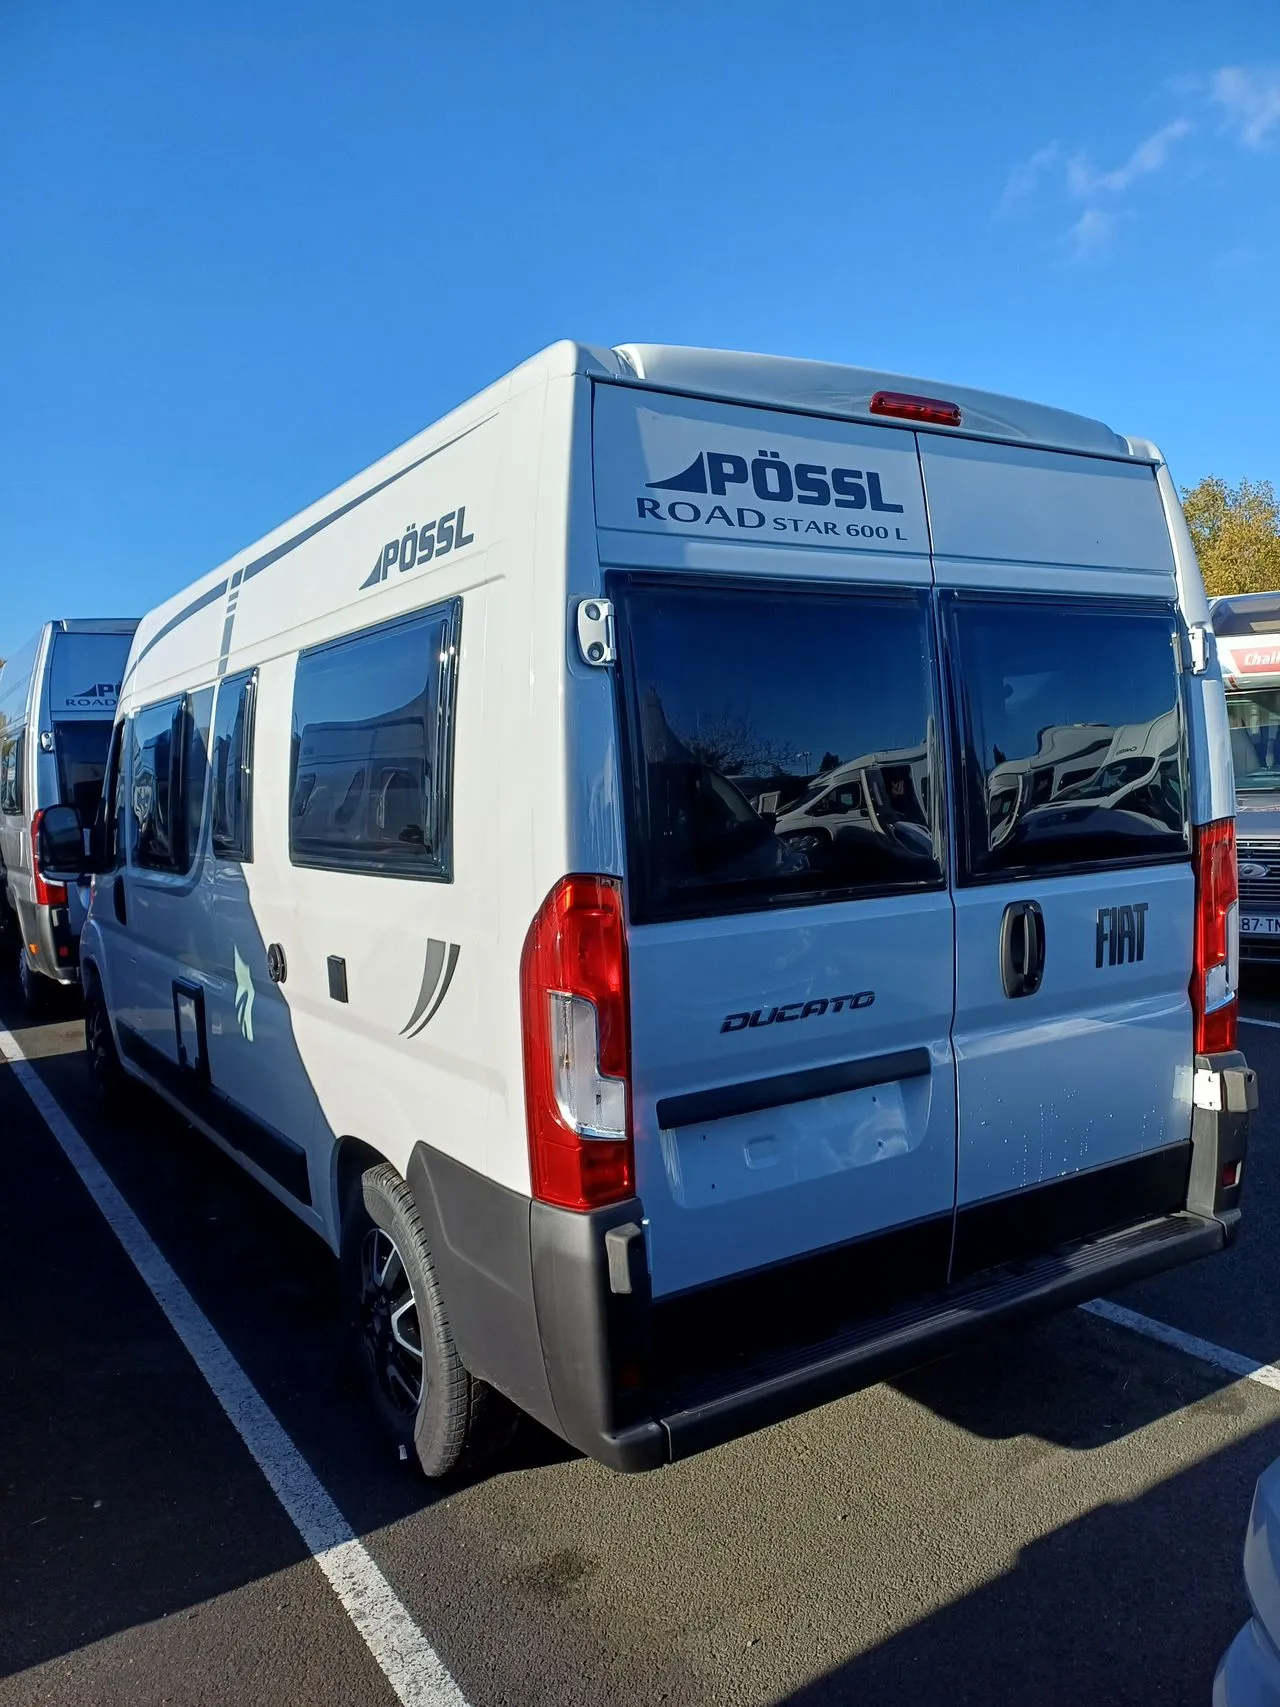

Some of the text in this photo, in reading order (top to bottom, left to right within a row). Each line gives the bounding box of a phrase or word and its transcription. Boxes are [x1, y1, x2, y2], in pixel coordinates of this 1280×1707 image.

[706, 450, 904, 513] PÖSSL
[381, 505, 474, 581] PÖSSL
[636, 497, 908, 541] ROAD STAR 600 L
[65, 698, 117, 706] ROAD
[1095, 902, 1149, 968] FIAT
[719, 990, 876, 1034] DUCATO
